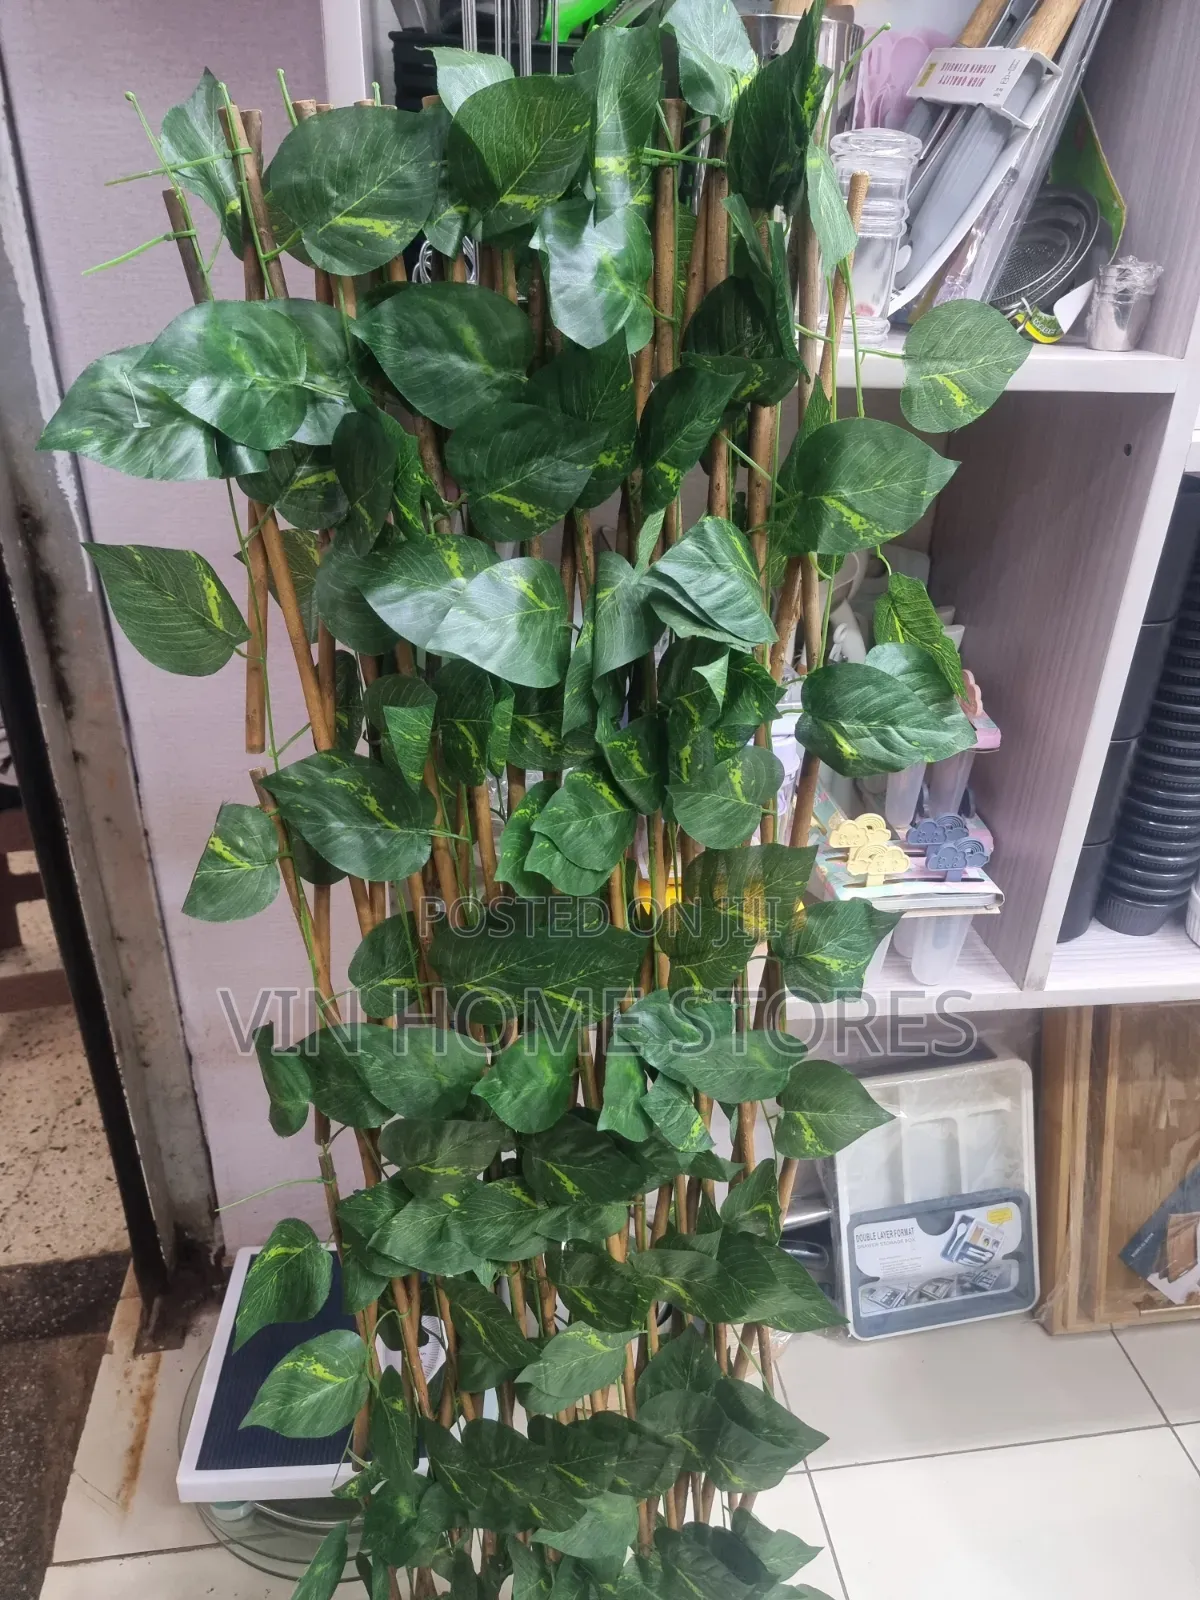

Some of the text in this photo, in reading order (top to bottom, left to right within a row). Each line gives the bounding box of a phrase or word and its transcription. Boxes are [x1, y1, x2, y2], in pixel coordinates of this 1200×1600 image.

[938, 75, 967, 86] QUALITY
[967, 77, 986, 87] HIGH
[856, 1227, 914, 1242] DOUBLE LAYER FORMAT
